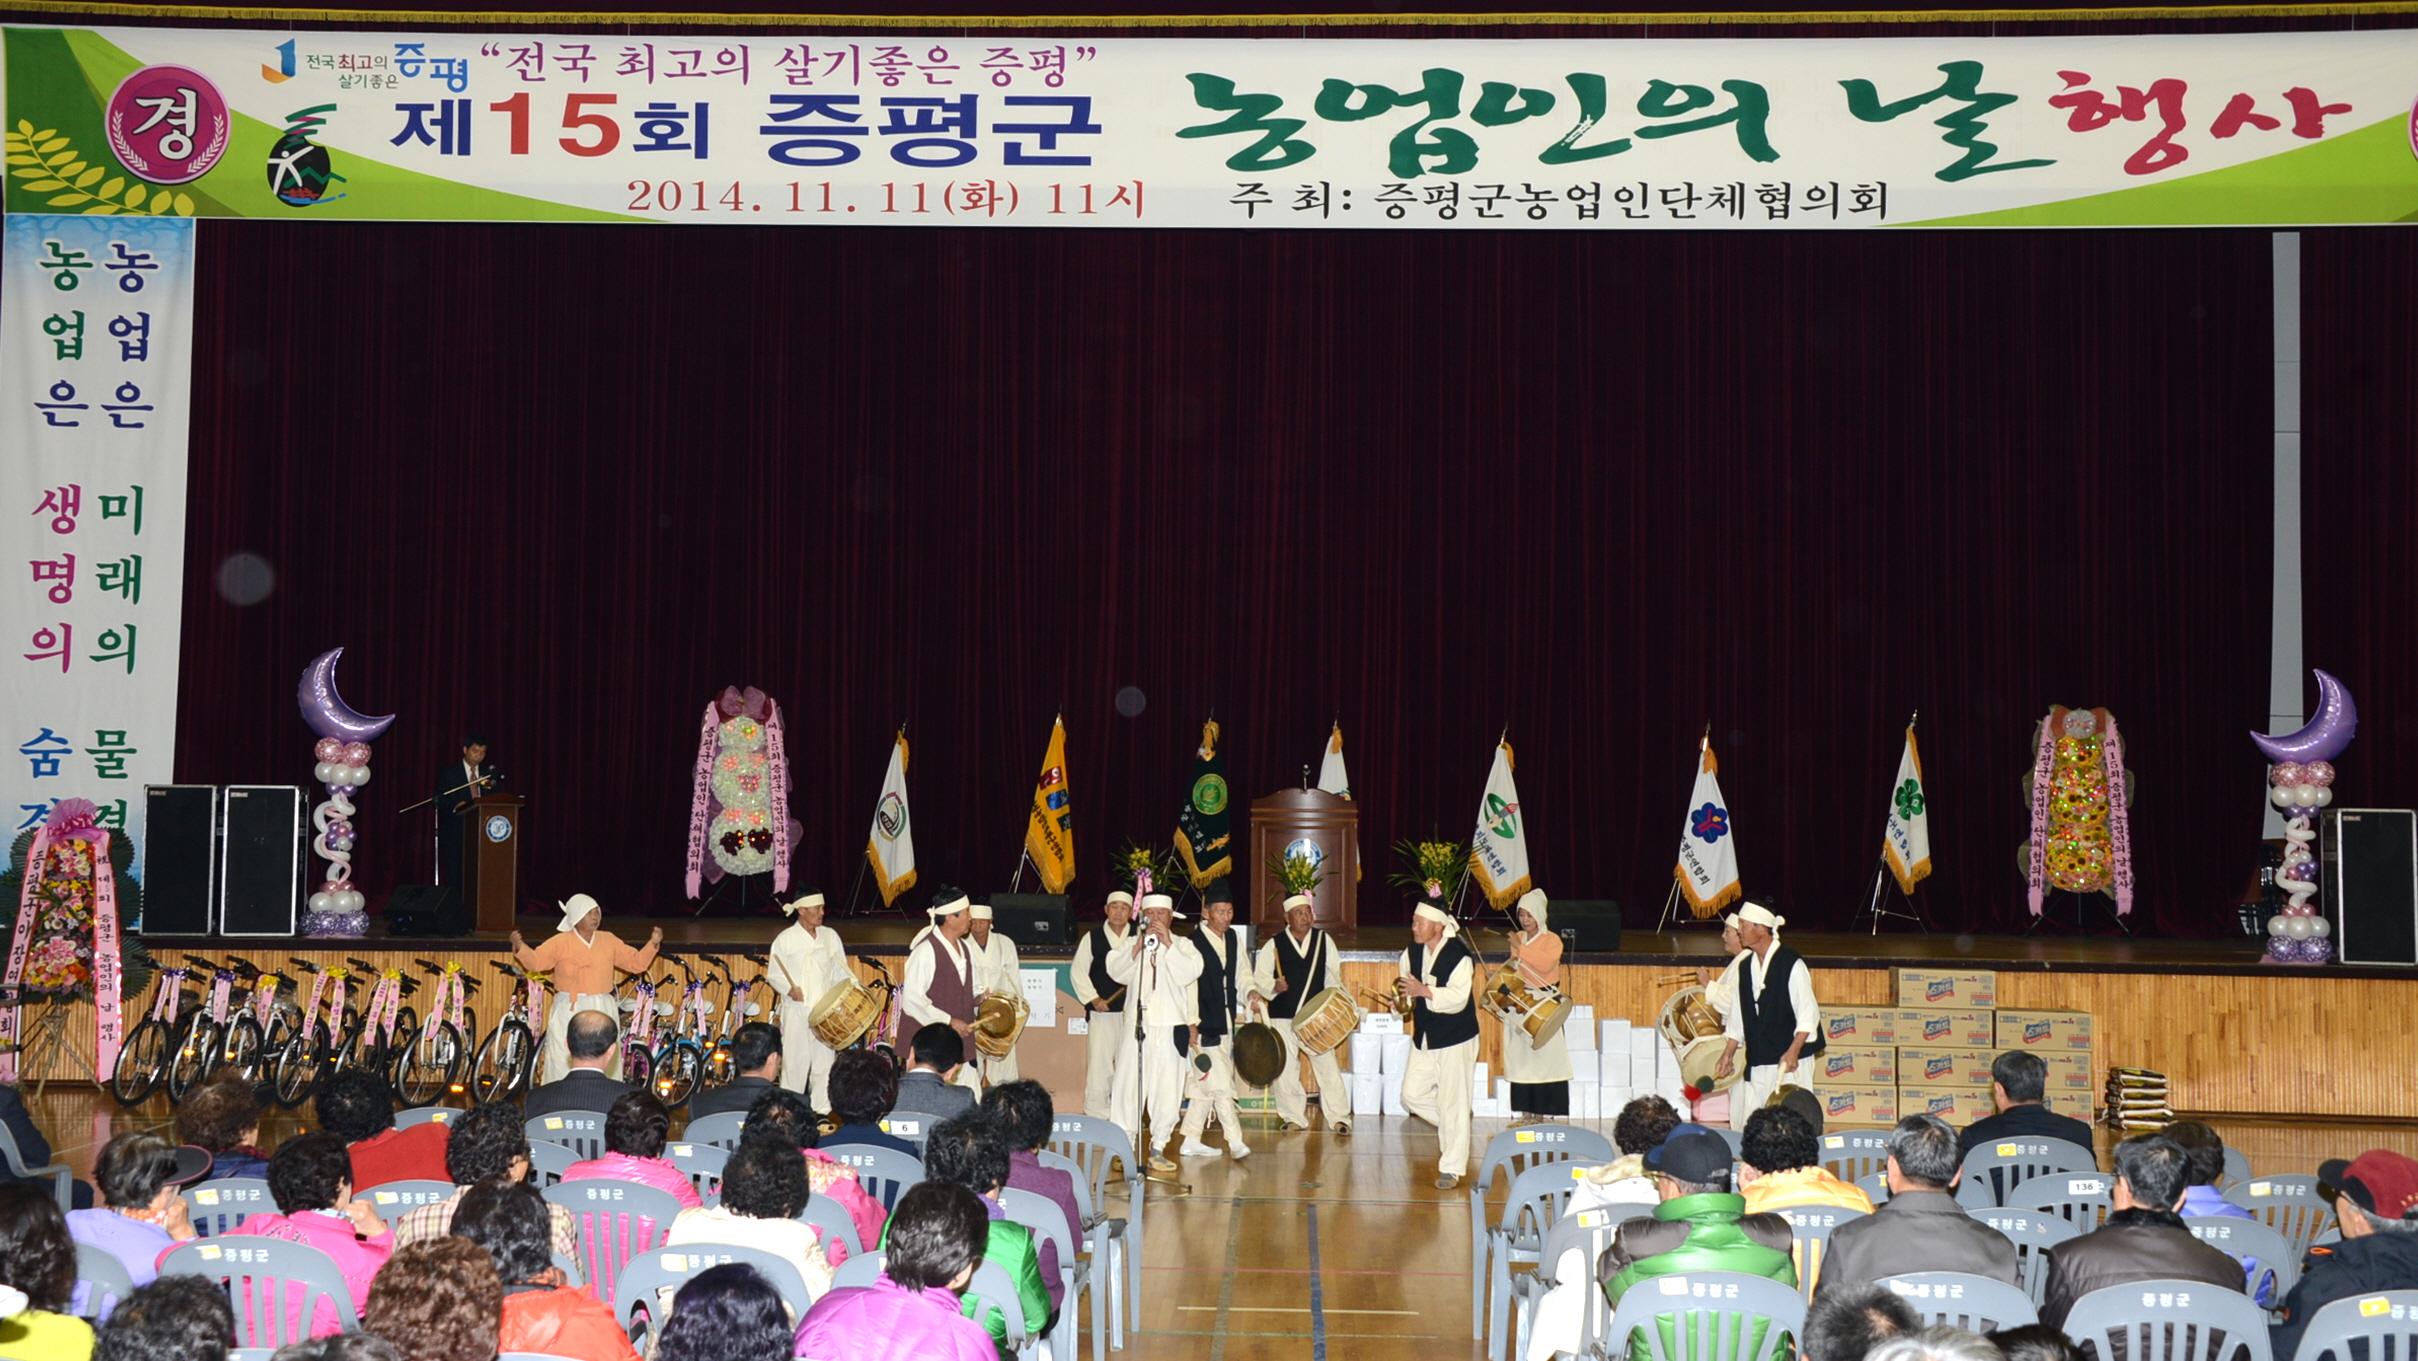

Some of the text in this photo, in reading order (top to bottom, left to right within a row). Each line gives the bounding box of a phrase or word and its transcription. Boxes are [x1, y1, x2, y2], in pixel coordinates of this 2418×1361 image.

[306, 53, 388, 72] 전국 최고의
[394, 43, 468, 93] 증평
[480, 41, 1097, 88] “전국 최고의 살기좋은 증평”
[338, 74, 399, 90] 살기좋은
[132, 87, 198, 161] 경
[390, 92, 1101, 168] 제15회 증평군
[1175, 60, 2353, 183] 농업인의 날 행사
[626, 178, 1145, 219] 2014. 11. 11(화) 11시
[1229, 180, 1889, 220] 주 최: 증평군농업인단체협의회
[34, 241, 94, 428] 농업은
[100, 243, 159, 429] 농업은
[23, 483, 82, 674] 생명의
[89, 484, 144, 675] 미래의
[700, 726, 717, 763] 증평군
[2036, 741, 2054, 779] 증평군
[771, 764, 784, 792] 증평군
[2109, 782, 2124, 811] 증평군
[772, 796, 786, 834] 농업인의
[2111, 815, 2128, 853] 농업인의
[565, 1119, 595, 1130] 증평군
[902, 1124, 908, 1132] 6
[1535, 1132, 1566, 1142] 증평군
[401, 1192, 441, 1205] 증평군
[586, 1188, 624, 1200] 증평군
[2075, 1182, 2094, 1191] 136
[224, 1249, 269, 1263] 증평군
[2142, 1293, 2190, 1308] 증평군
